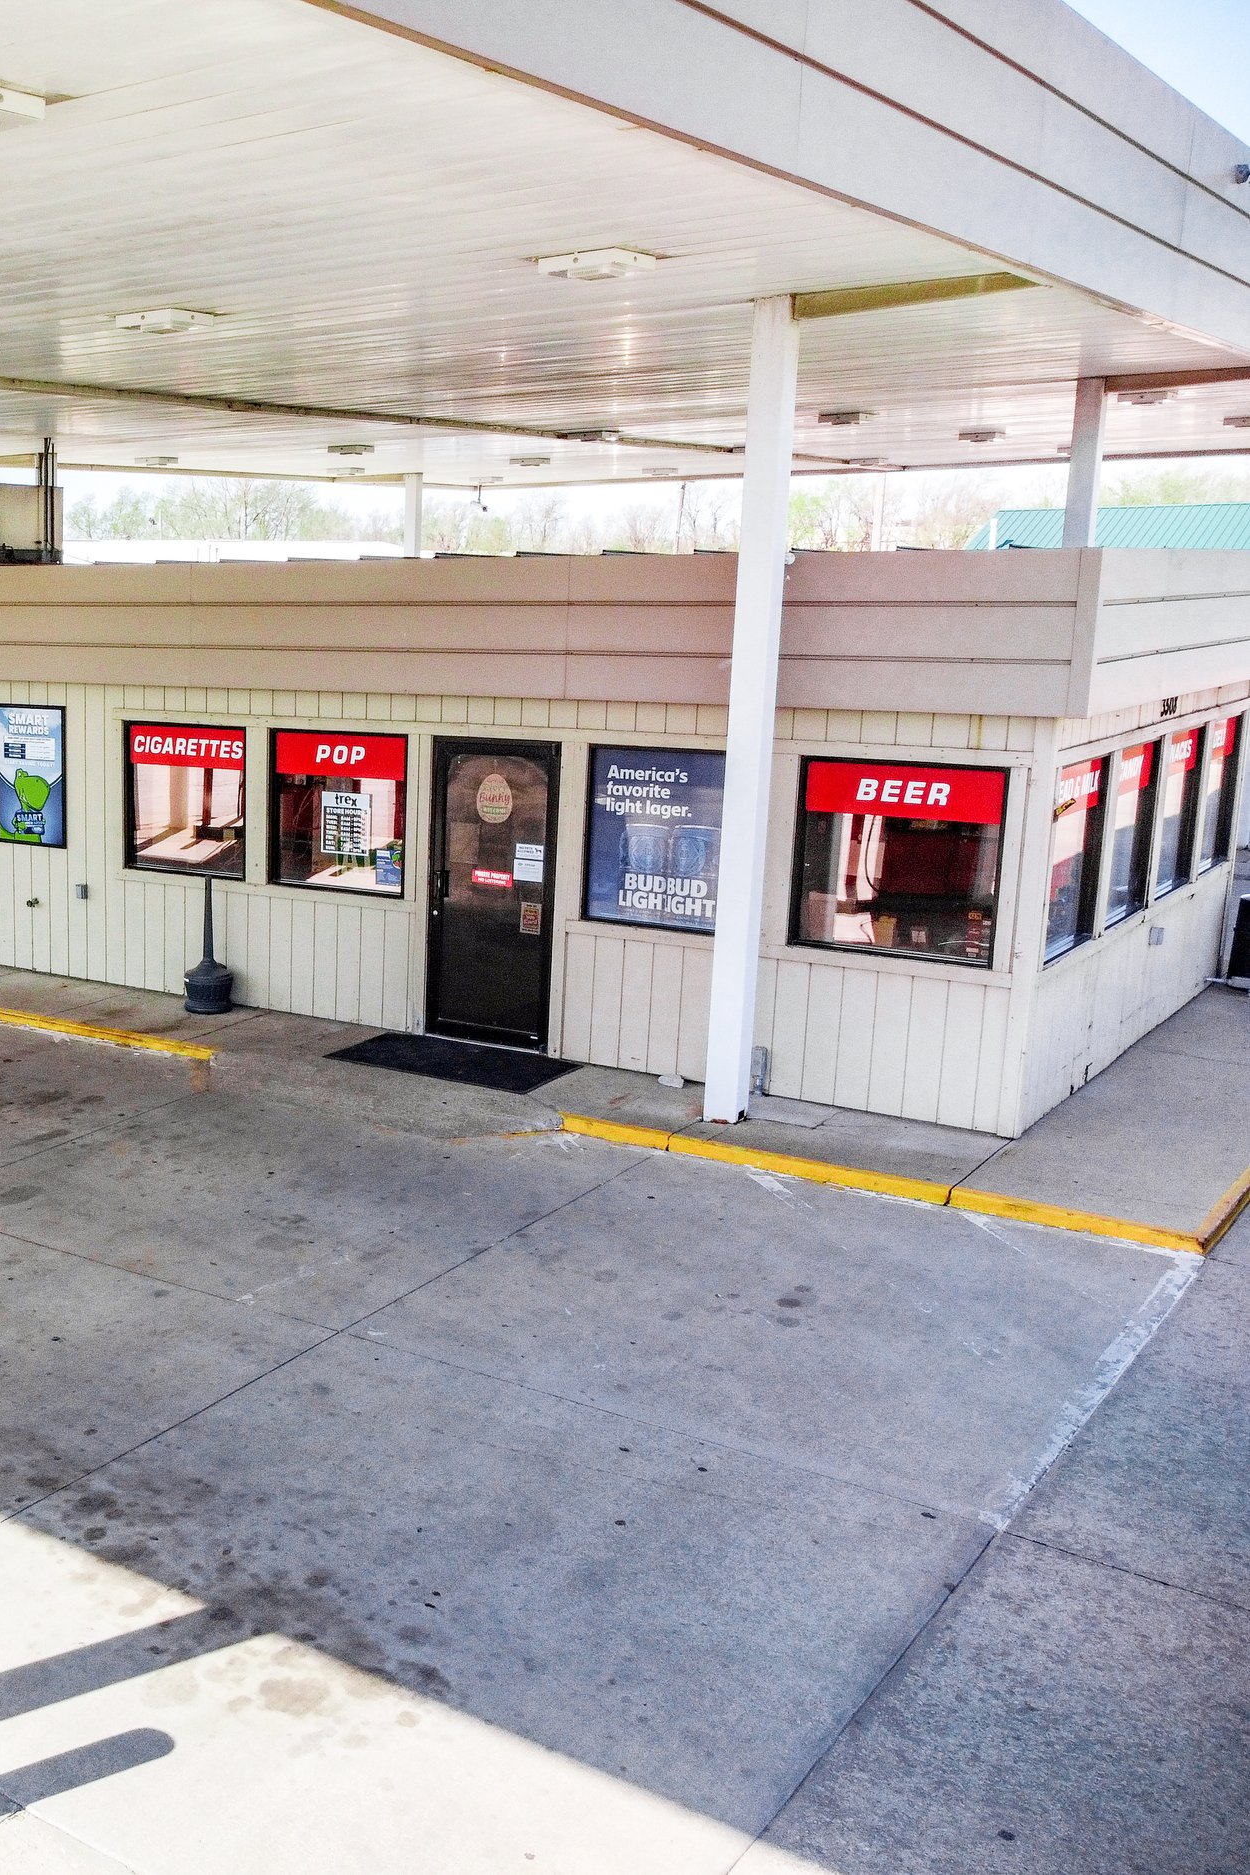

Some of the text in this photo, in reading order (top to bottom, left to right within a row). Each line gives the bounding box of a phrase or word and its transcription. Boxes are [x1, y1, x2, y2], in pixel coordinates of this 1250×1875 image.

[8, 712, 49, 726] SMART
[8, 724, 50, 736] REWARDS
[133, 735, 244, 760] CIGARETTES
[315, 744, 366, 765] POP
[607, 764, 688, 783] America's
[607, 781, 671, 799] favorite
[856, 778, 950, 806] BEER
[334, 793, 358, 807] trex
[605, 797, 692, 819] light lager.
[16, 813, 43, 822] SMART
[624, 873, 667, 893] BUD
[667, 877, 708, 898] BUD
